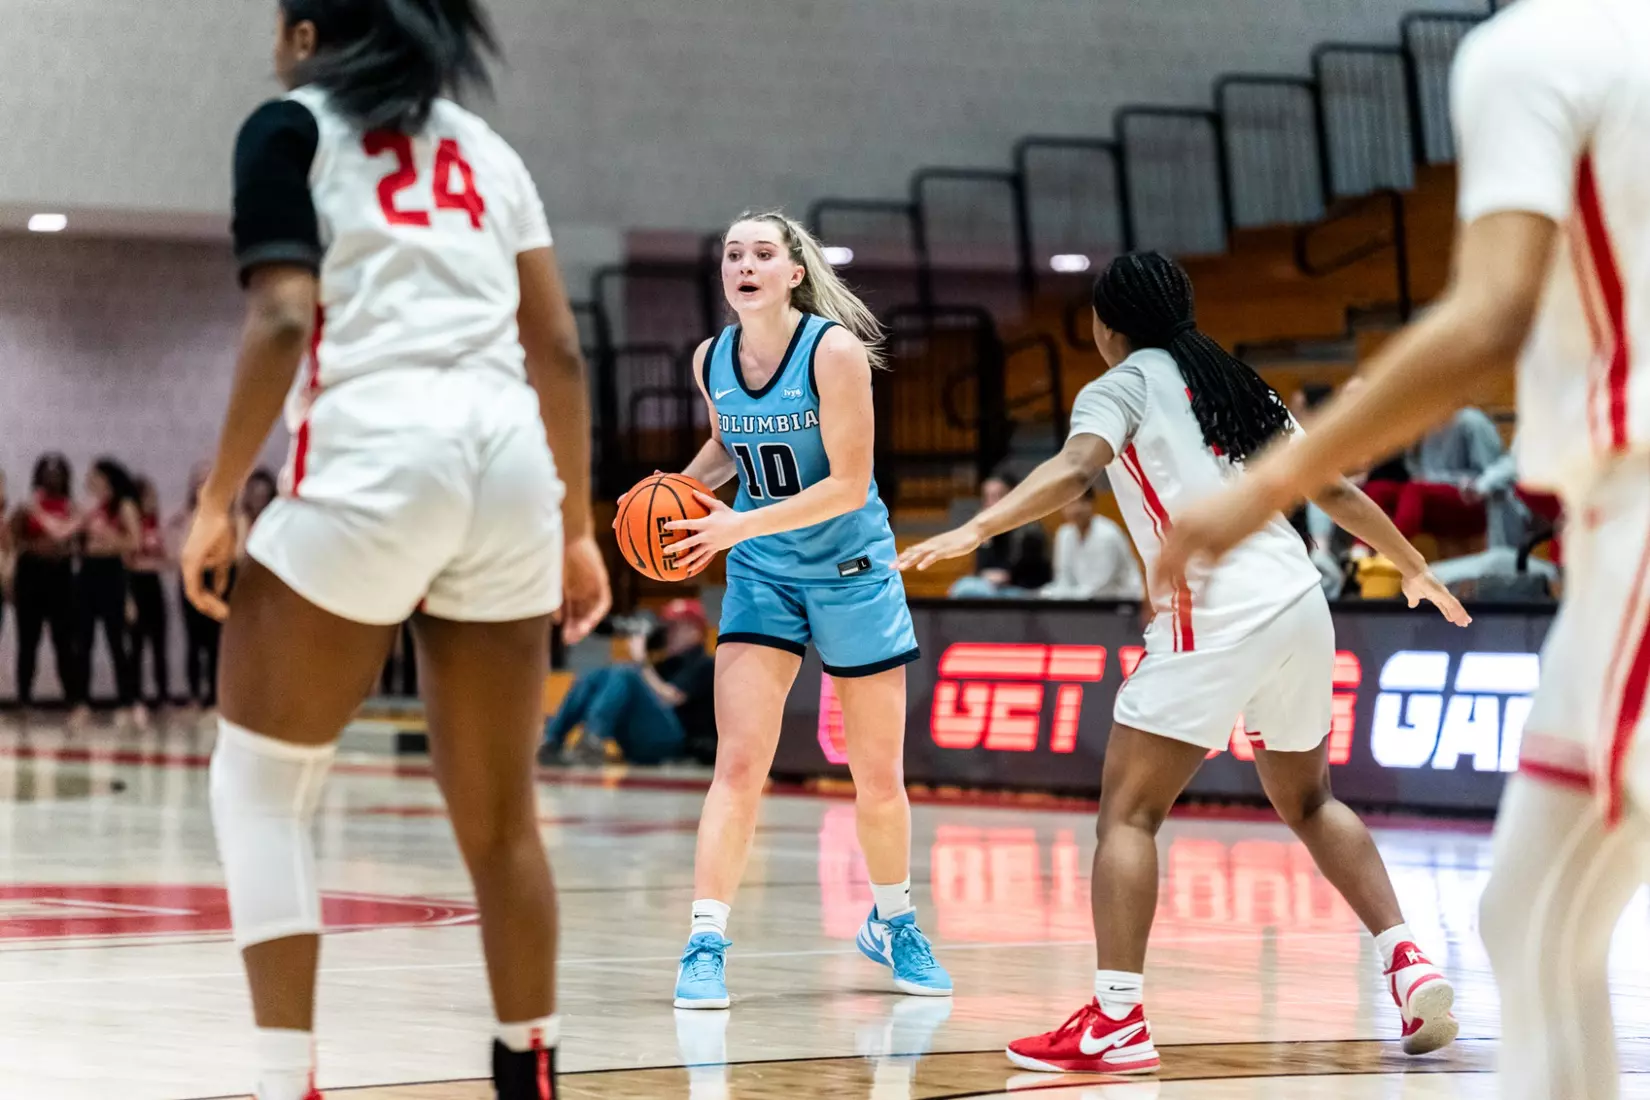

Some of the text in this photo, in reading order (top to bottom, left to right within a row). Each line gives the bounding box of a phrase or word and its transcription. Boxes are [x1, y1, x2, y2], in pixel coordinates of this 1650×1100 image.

[362, 127, 486, 231] 24
[731, 442, 803, 500] 10
[930, 642, 1107, 754] GET
